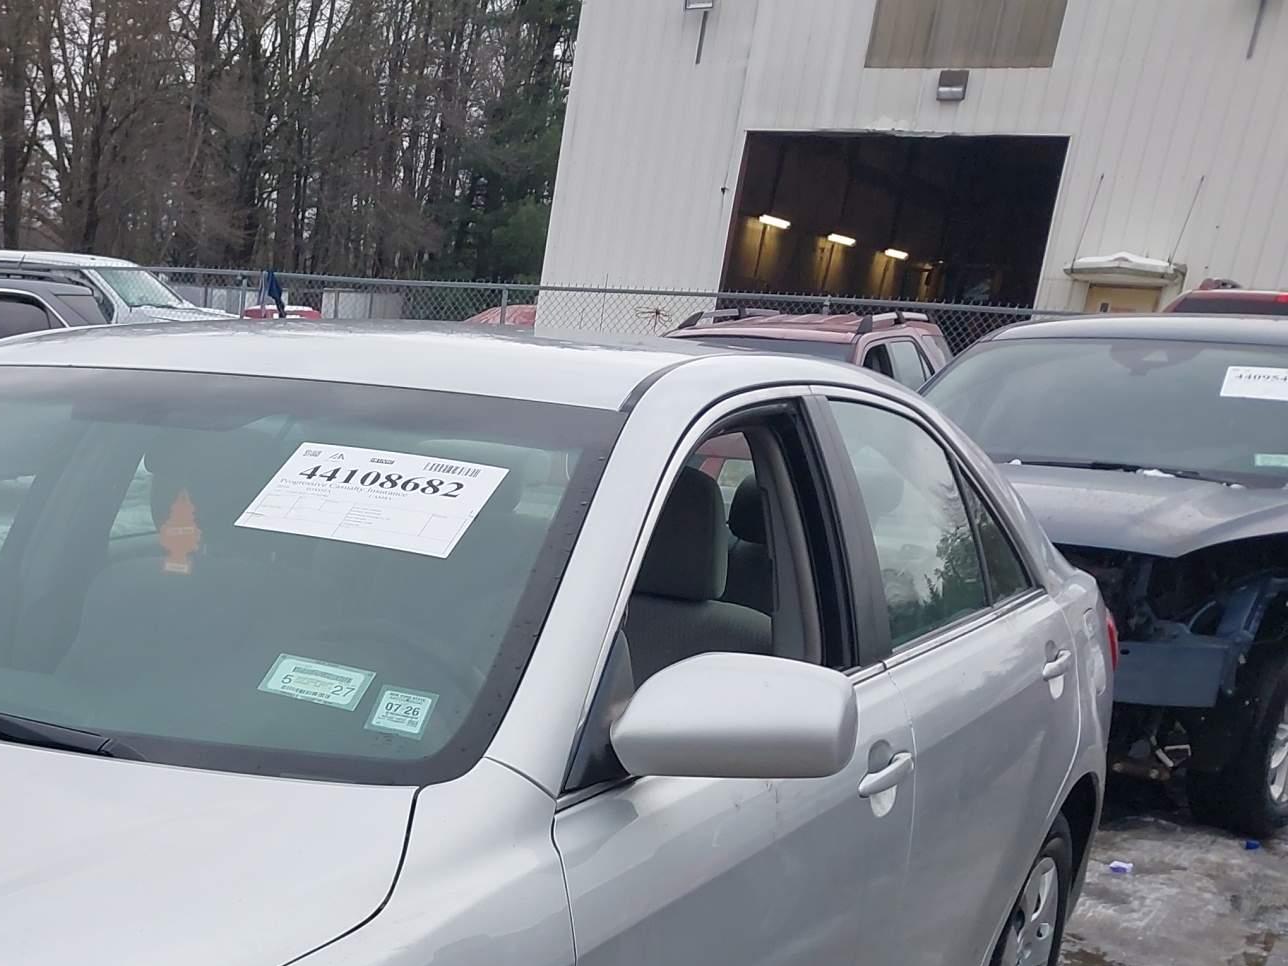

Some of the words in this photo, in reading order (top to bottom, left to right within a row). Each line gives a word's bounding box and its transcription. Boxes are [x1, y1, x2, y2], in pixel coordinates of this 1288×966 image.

[299, 464, 464, 498] 44108682
[281, 674, 294, 684] 5
[331, 685, 356, 697] 27
